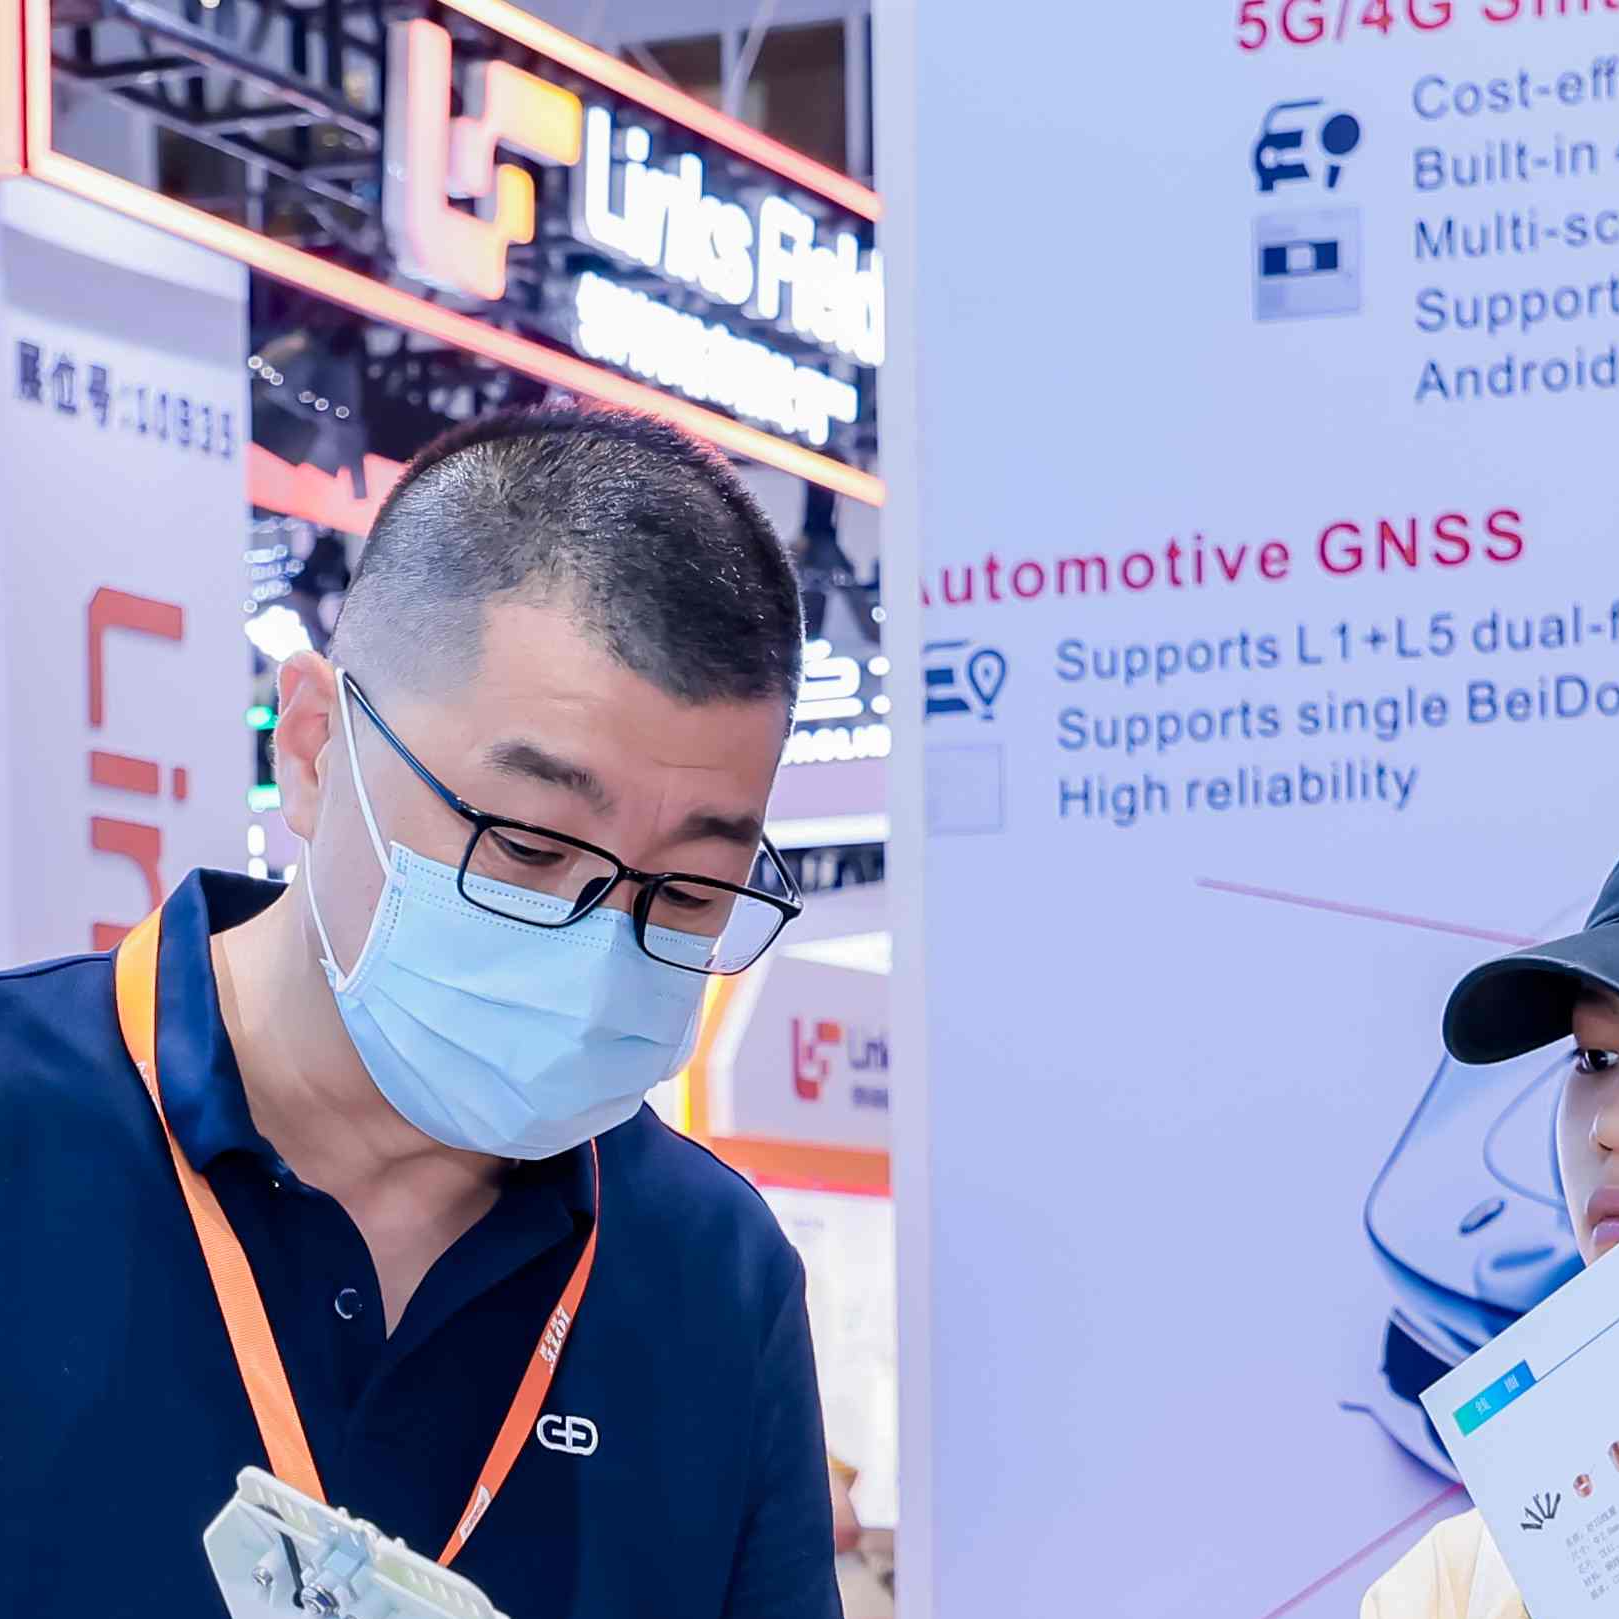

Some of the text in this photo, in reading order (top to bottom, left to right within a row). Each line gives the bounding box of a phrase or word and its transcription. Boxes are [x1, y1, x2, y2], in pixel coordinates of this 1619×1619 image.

[1413, 123, 1598, 191] Built-in
[585, 106, 754, 305] Links
[757, 195, 885, 366] Field
[1415, 341, 1618, 404] Android
[919, 507, 1528, 607] utomotive GNSS
[1056, 625, 1280, 686] Supports
[1297, 614, 1457, 669] L1+L5
[1057, 697, 1285, 757] Supports
[1297, 685, 1449, 743] single
[1058, 757, 1419, 829] High reliability
